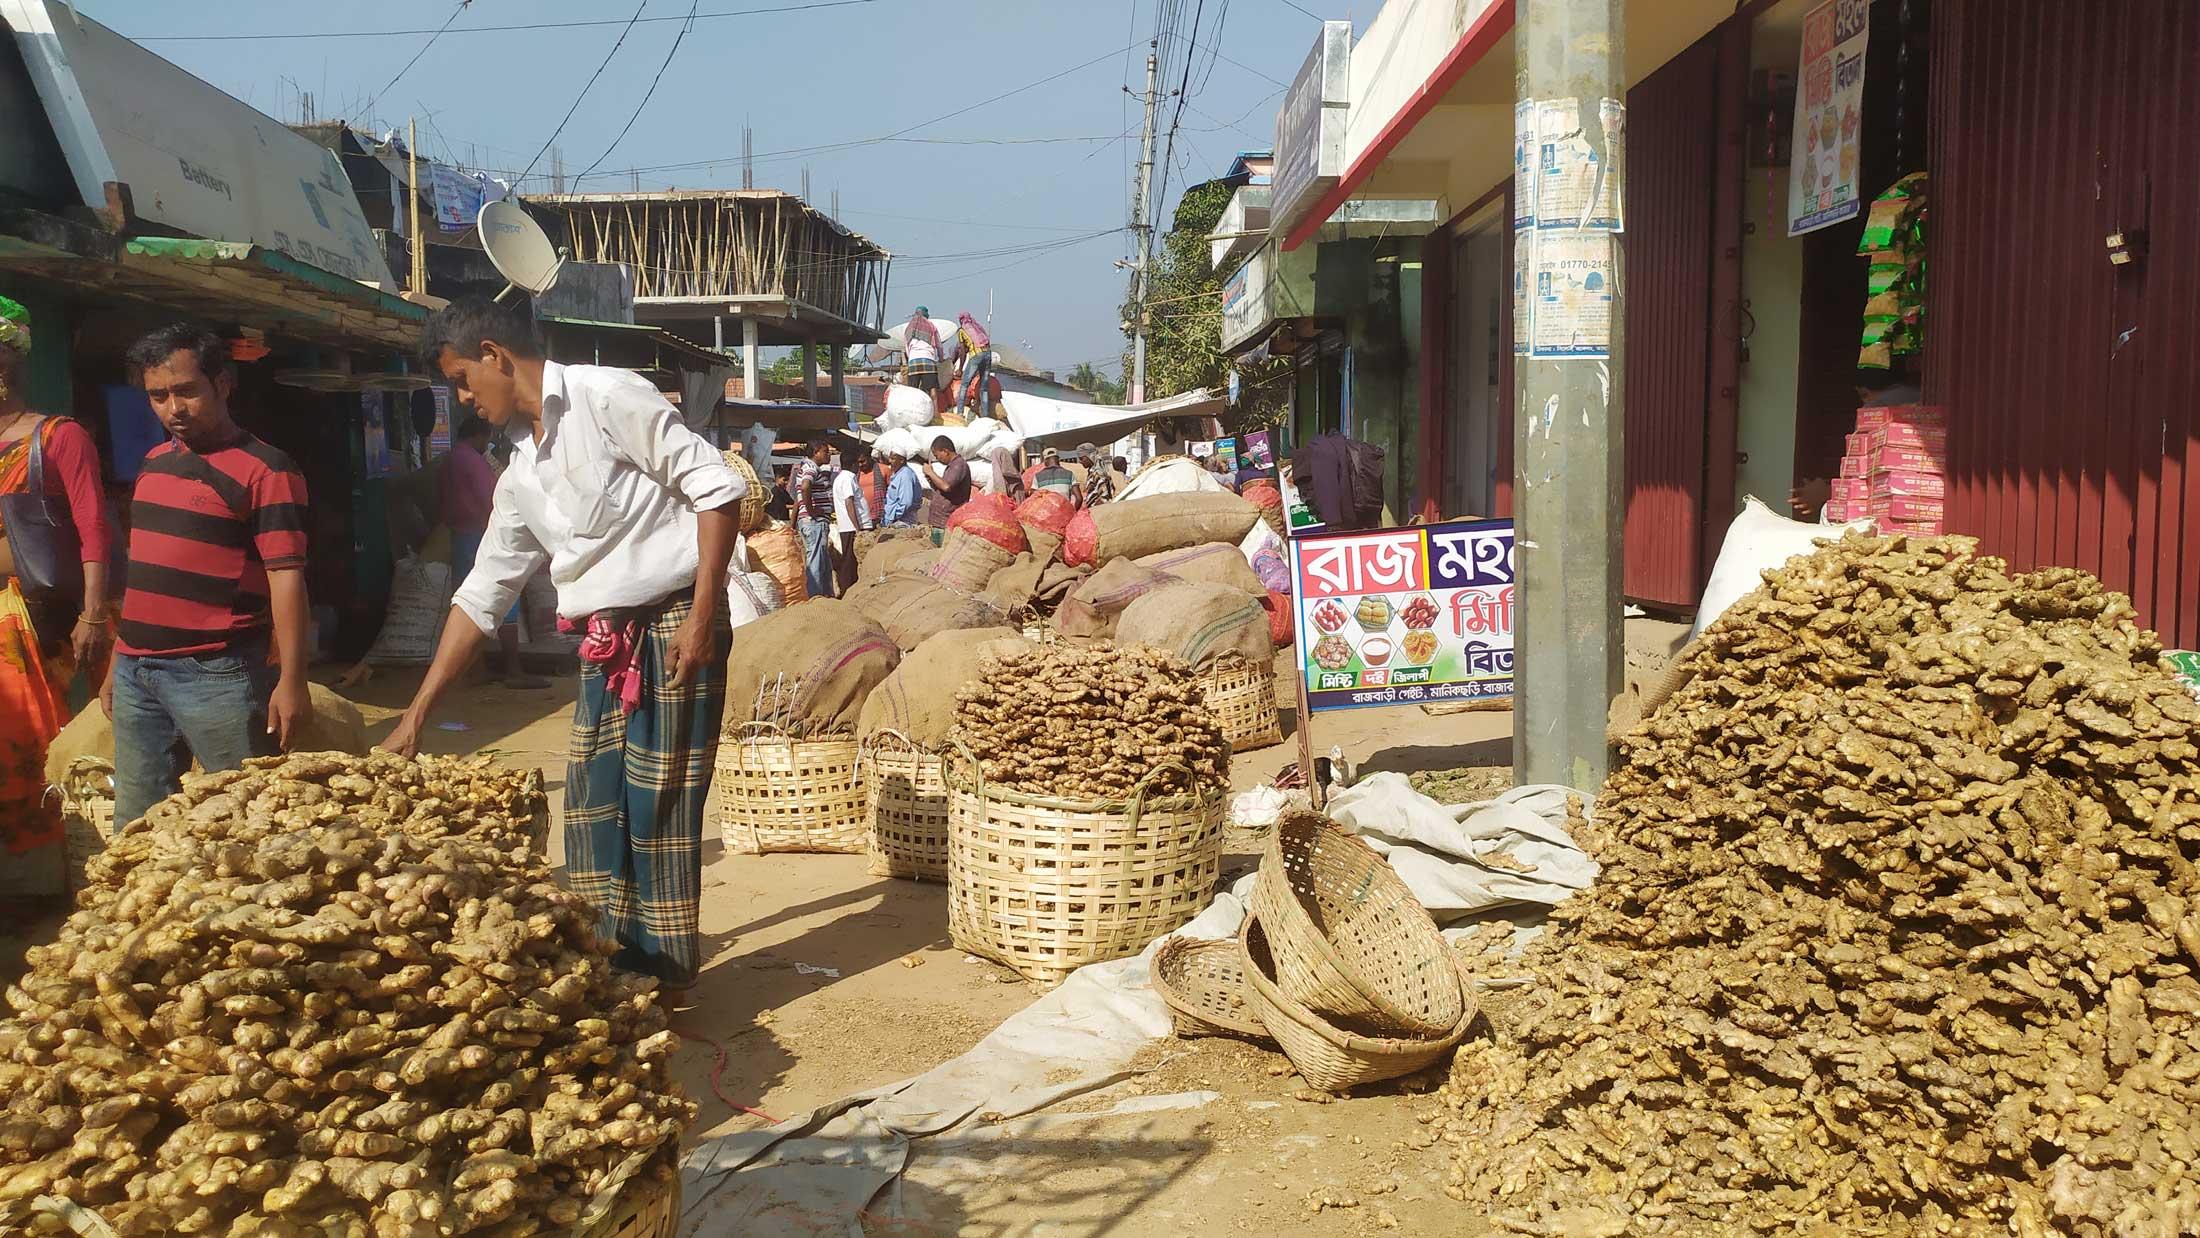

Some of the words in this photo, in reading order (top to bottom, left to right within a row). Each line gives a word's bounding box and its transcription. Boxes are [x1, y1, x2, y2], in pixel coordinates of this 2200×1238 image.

[178, 157, 232, 201] Battery
[1302, 534, 1419, 594] রাজ
[1433, 528, 1514, 582] মহ
[1464, 640, 1514, 676] বিত
[1322, 671, 1354, 688] মিষ্টি
[1365, 671, 1385, 685] দই
[1393, 668, 1429, 683] জিলাপী
[1352, 688, 1397, 704] রাজবাড়ী
[1430, 682, 1480, 699] মানিকছড়ি
